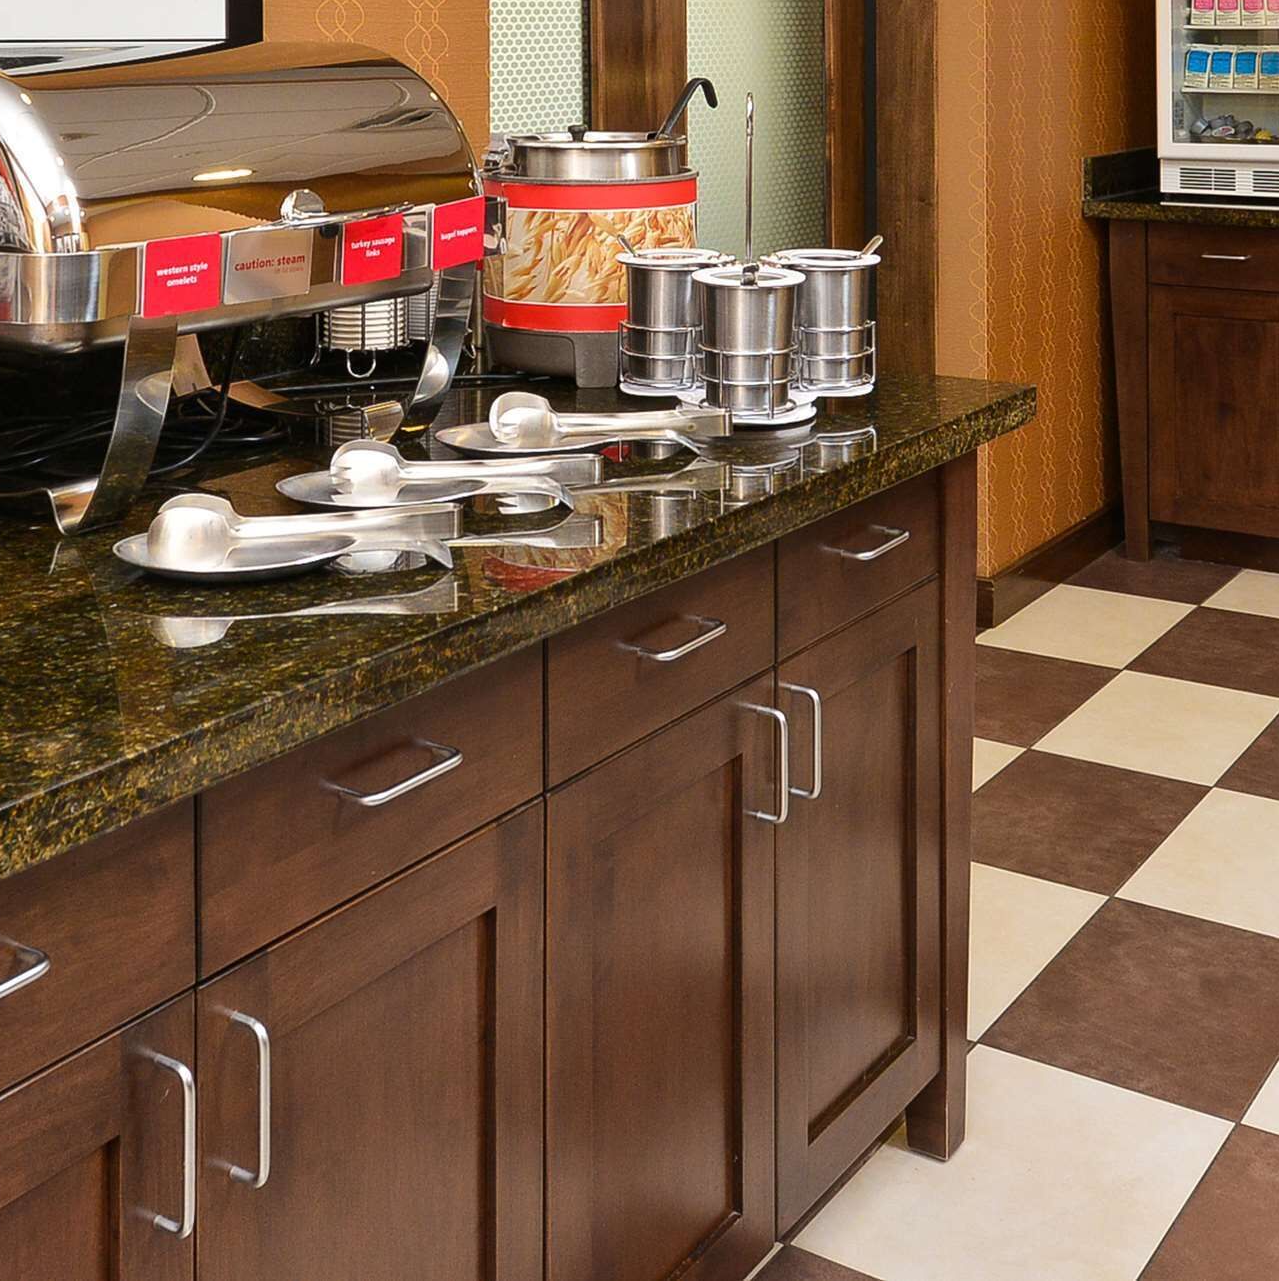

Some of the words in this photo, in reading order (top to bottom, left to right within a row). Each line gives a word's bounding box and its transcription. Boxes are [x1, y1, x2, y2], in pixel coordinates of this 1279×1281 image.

[156, 266, 189, 276] western
[190, 261, 208, 273] style
[234, 258, 275, 271] caution:
[276, 254, 305, 266] steam
[166, 276, 197, 287] omelets
